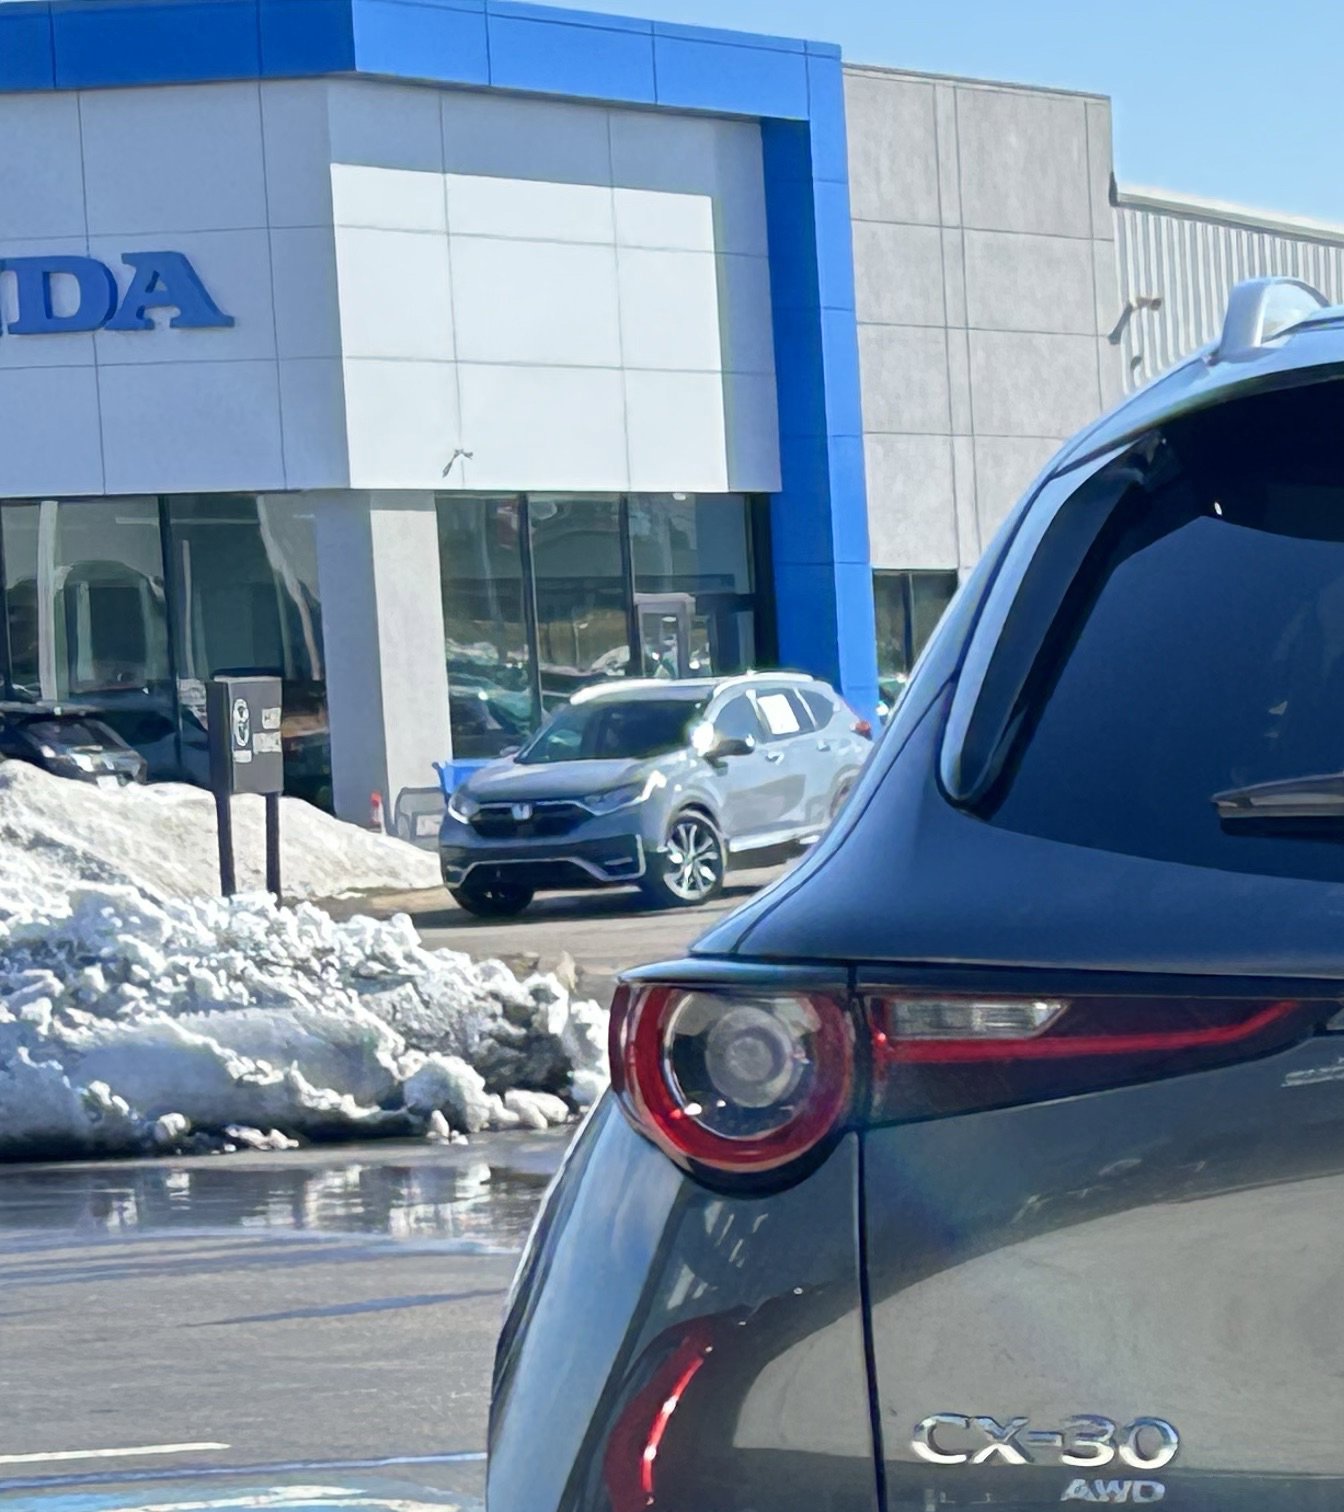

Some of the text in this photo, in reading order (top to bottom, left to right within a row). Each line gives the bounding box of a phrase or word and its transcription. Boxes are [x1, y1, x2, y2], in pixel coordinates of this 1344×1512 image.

[0, 250, 235, 335] DA
[910, 1411, 1180, 1470] CX-30
[1059, 1477, 1167, 1504] AWD
